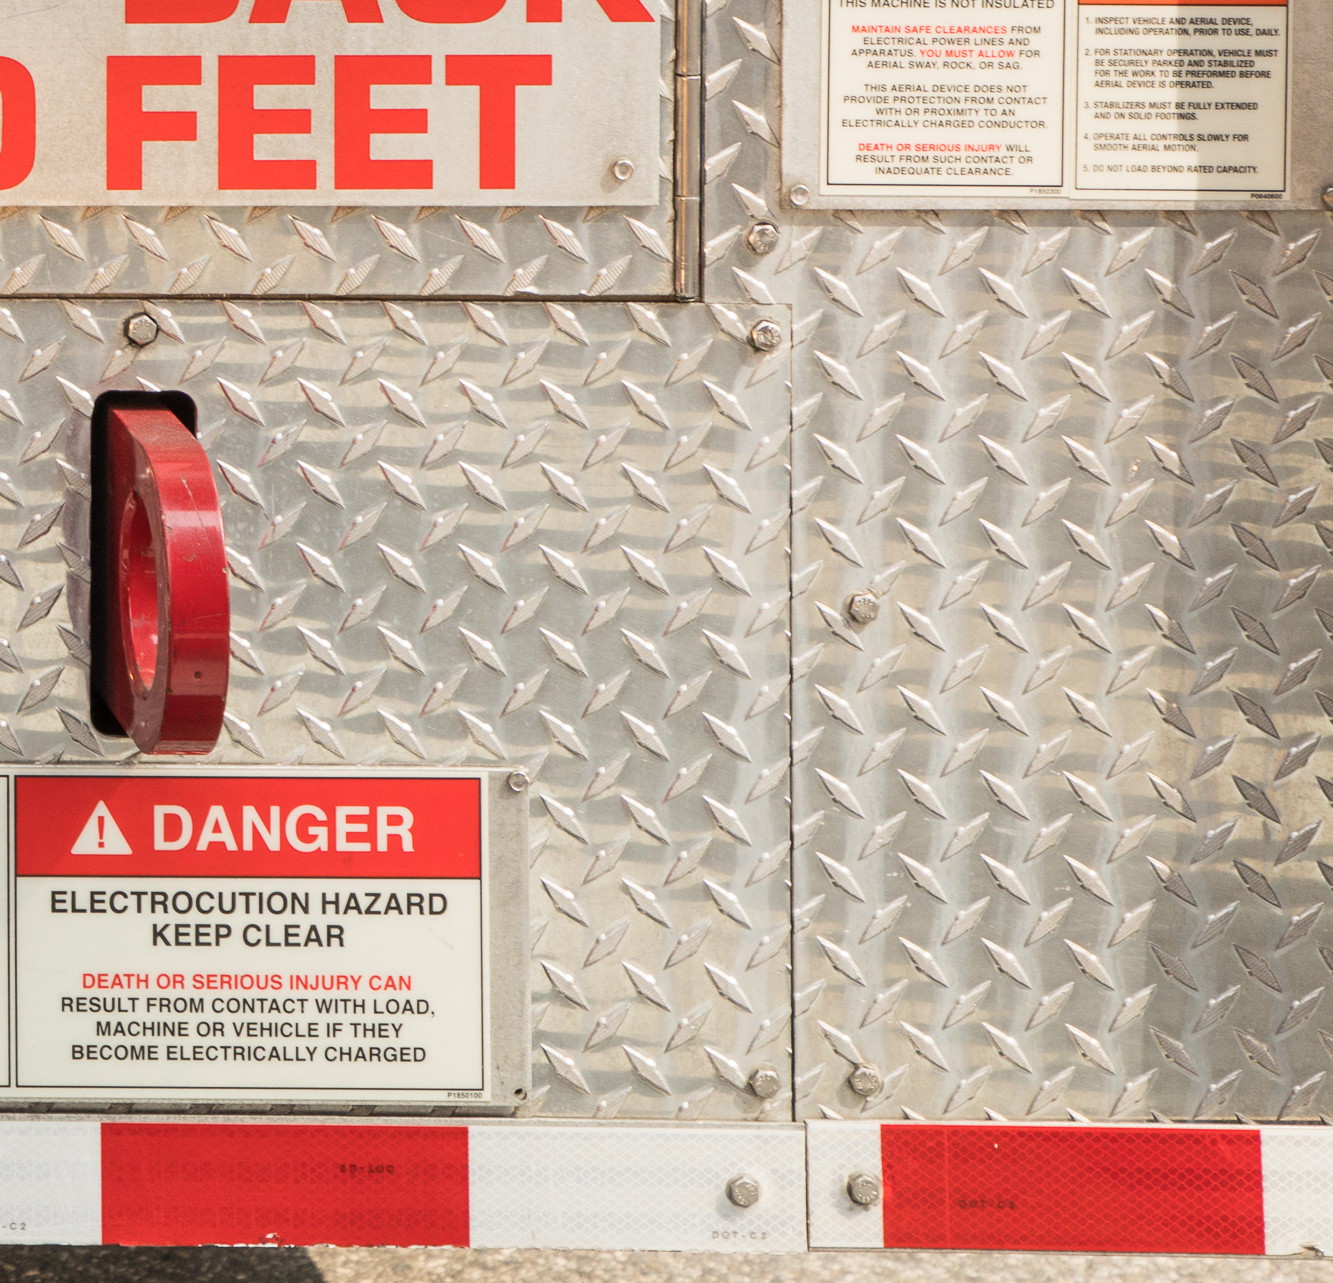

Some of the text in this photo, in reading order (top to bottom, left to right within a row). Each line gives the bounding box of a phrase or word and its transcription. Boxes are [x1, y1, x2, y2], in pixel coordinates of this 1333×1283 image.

[982, 0, 1054, 8] INSULATED
[1132, 17, 1165, 25] VEHICLE
[1169, 17, 1186, 25] AND
[905, 26, 931, 34] SAFE
[935, 26, 1007, 34] CLEARANCES
[1011, 26, 1041, 34] FROM
[1143, 28, 1191, 37] OPERATION,
[1193, 28, 1219, 36] PRIOR
[1221, 28, 1232, 36] TO
[1235, 28, 1253, 37] USE,
[1255, 28, 1280, 36] DAILY.
[863, 37, 928, 45] ELECTRICAL
[975, 38, 1004, 46] LINES
[1008, 38, 1029, 46] AND
[920, 50, 941, 58] YOU
[945, 50, 973, 58] MUST
[978, 50, 1015, 58] ALLOW
[1019, 50, 1040, 58] FOR
[864, 84, 887, 92] THIS
[891, 84, 928, 92] AERIAL
[974, 85, 1003, 93] DOES
[1007, 85, 1027, 93] NOT
[844, 96, 889, 104] PROVIDE
[893, 96, 960, 104] PROTECTION
[998, 97, 1047, 105] CONTACT
[905, 108, 919, 116] OR
[924, 108, 979, 116] PROXIMITY
[984, 108, 997, 116] TO
[106, 54, 552, 190] FEET
[842, 119, 1048, 128] ELECTRICALLY CHARGED CONDUCTOR.
[859, 143, 892, 151] DEATH
[915, 144, 961, 152] SERIOUS
[965, 144, 1001, 152] INJURY
[856, 155, 1033, 164] RESULT FROM SUCH CONTACT OR
[875, 167, 1014, 176] INADEQUATE CLEARANCE.
[154, 805, 414, 852] DANGER
[51, 891, 447, 915] ELECTROCUTION HAZARD
[153, 924, 344, 947] KEEP CLEAR
[83, 974, 411, 990] DEATH OR SERIOUS INJURY CAN
[62, 997, 434, 1016] RESULT FROM CONTACT WITH LOAD,
[97, 1021, 403, 1038] MACHINE OR VEHICLE IF THEY
[72, 1045, 426, 1062] BECOME ELECTRICALLY CHARGED
[712, 1231, 767, 1240] DOT-C2
